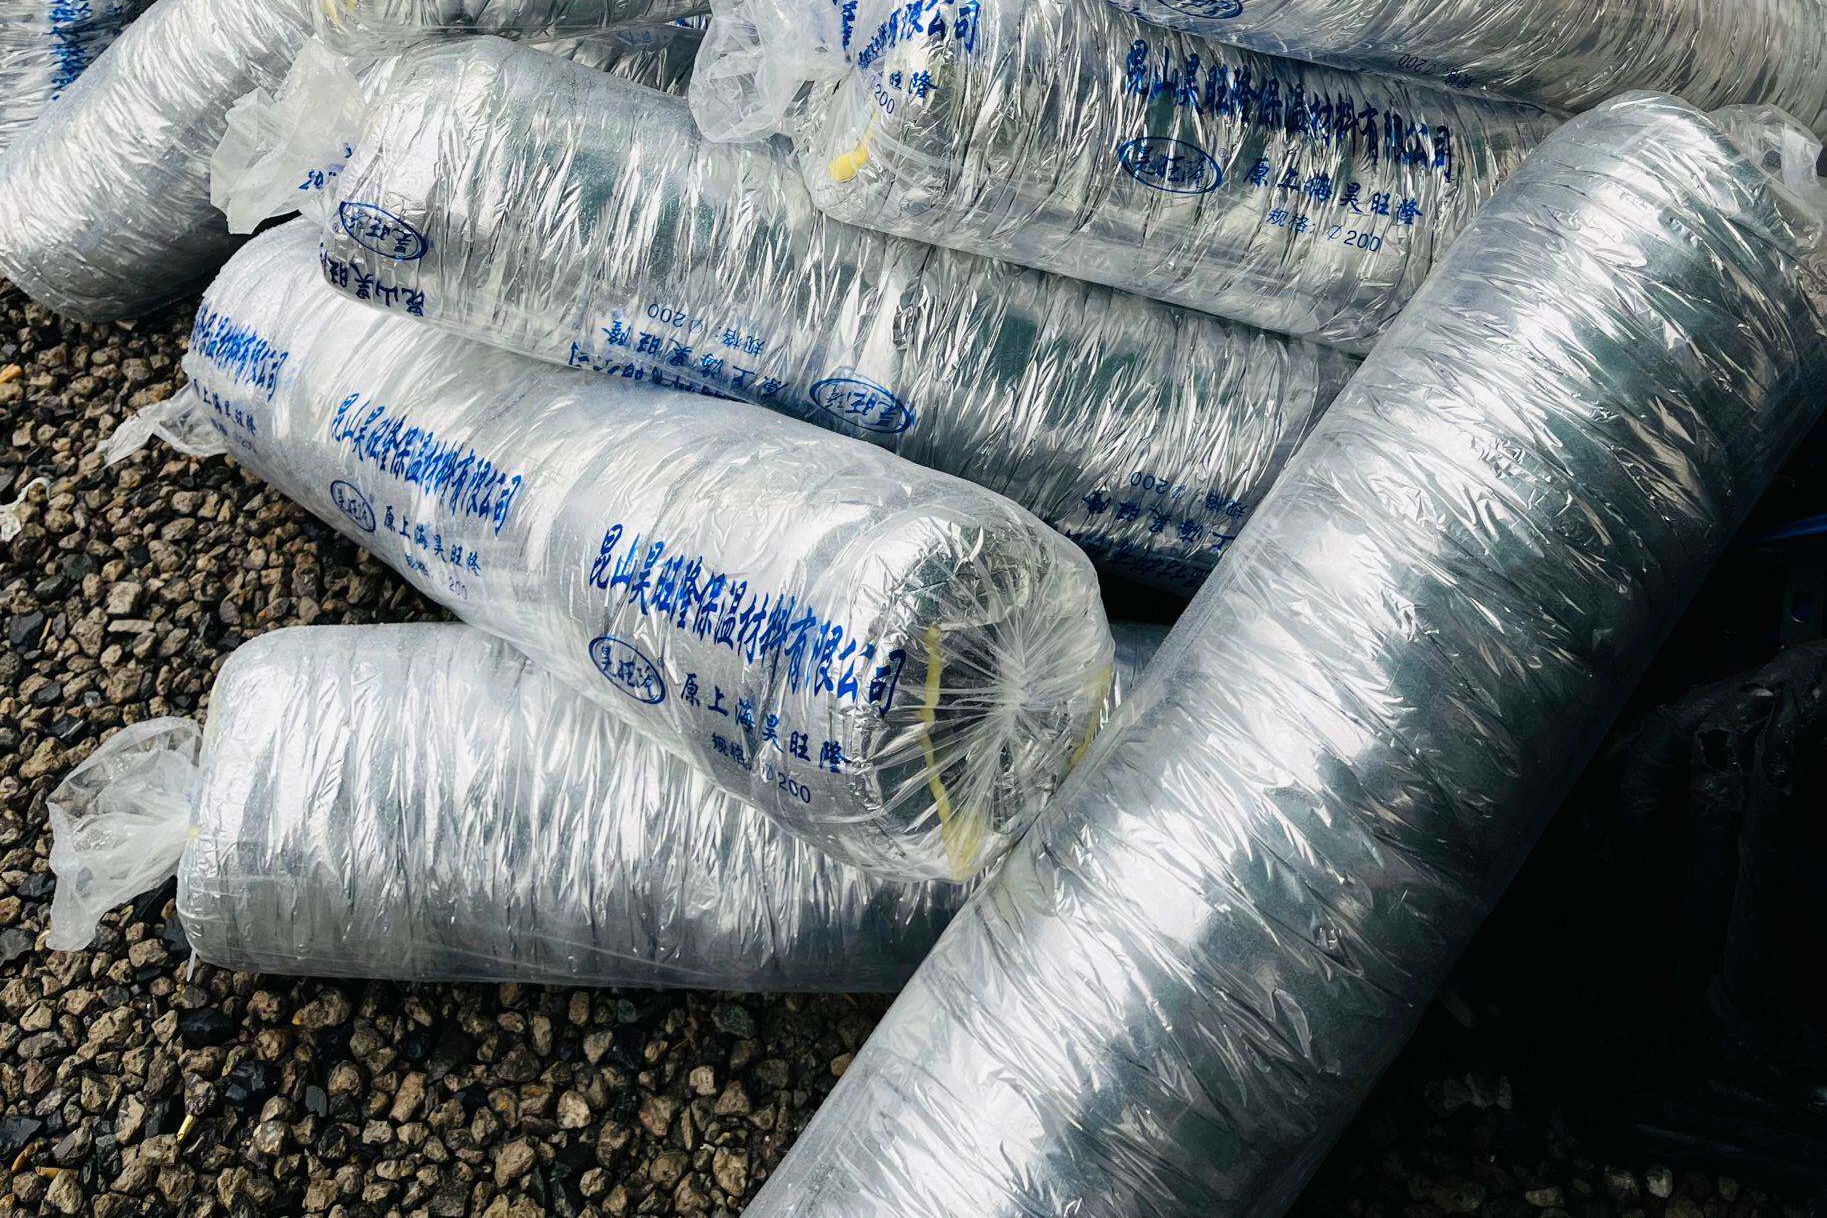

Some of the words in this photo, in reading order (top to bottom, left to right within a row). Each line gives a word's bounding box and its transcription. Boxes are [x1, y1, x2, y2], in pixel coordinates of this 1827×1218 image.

[589, 523, 906, 718] 昆山昊旺隆保温材料有限公司
[681, 673, 851, 774] 原上海昊旺隆
